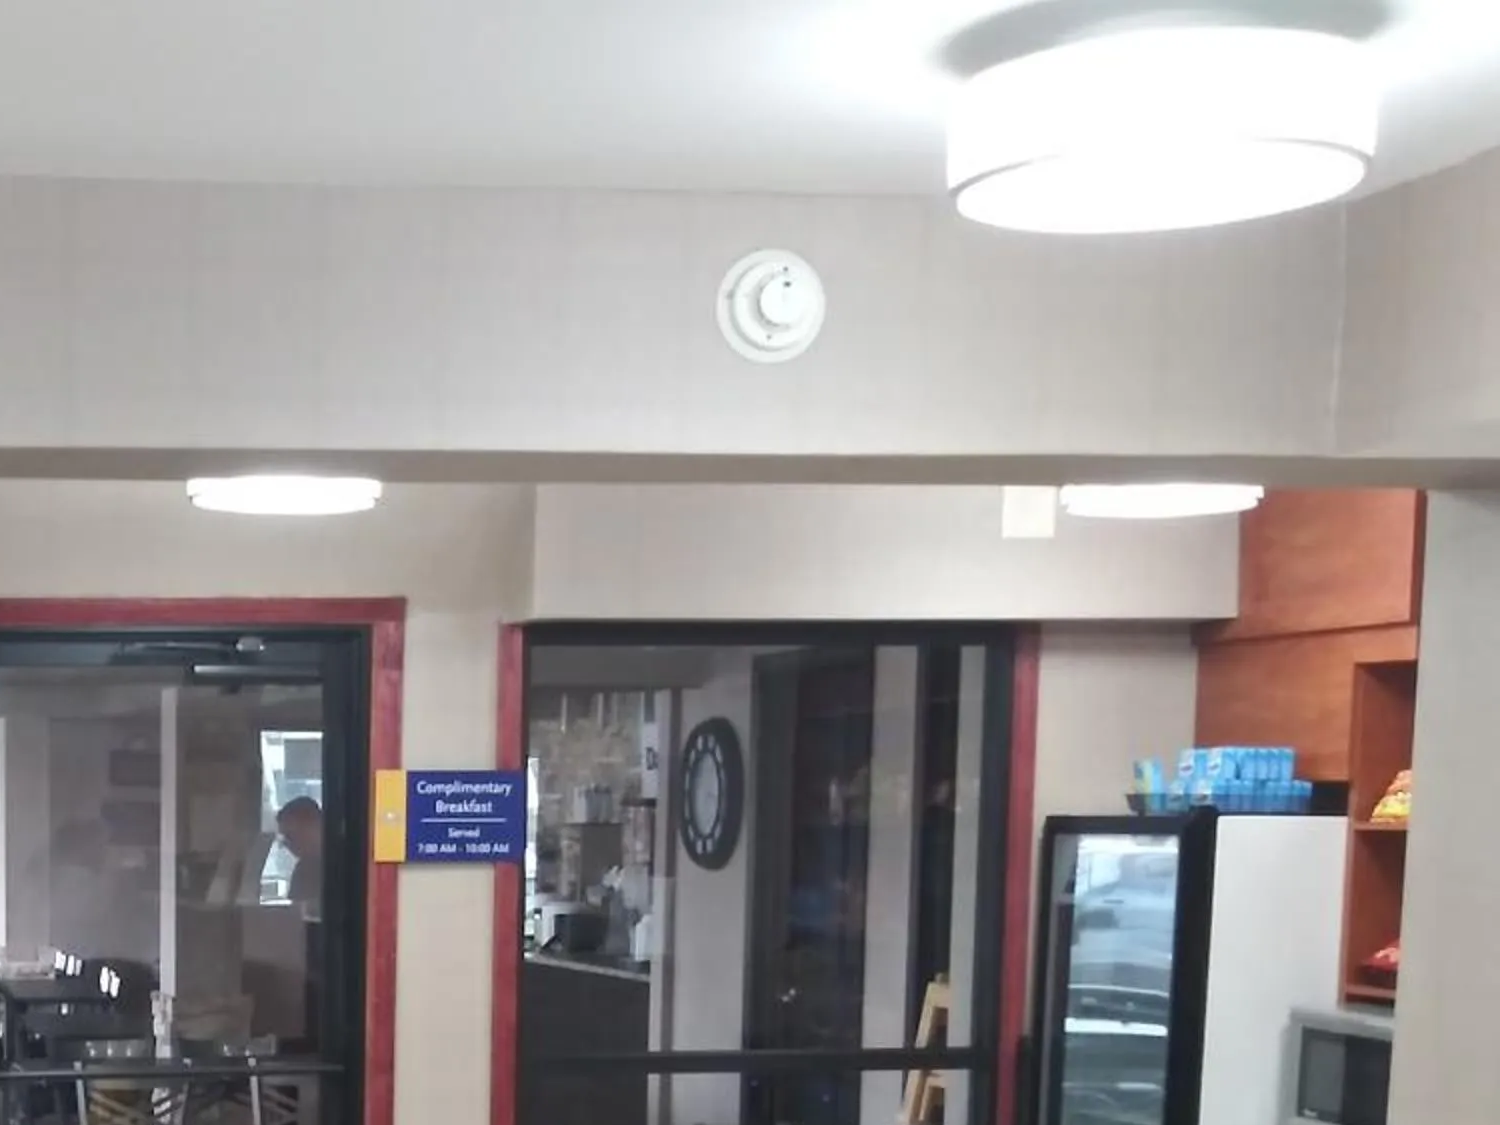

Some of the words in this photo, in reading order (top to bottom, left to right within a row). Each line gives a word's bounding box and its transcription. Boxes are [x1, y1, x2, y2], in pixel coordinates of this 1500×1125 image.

[417, 780, 512, 797] Complimentary
[435, 799, 493, 813] Breakfast
[448, 827, 480, 838] Served
[440, 844, 457, 853] AM
[493, 844, 510, 853] AM
